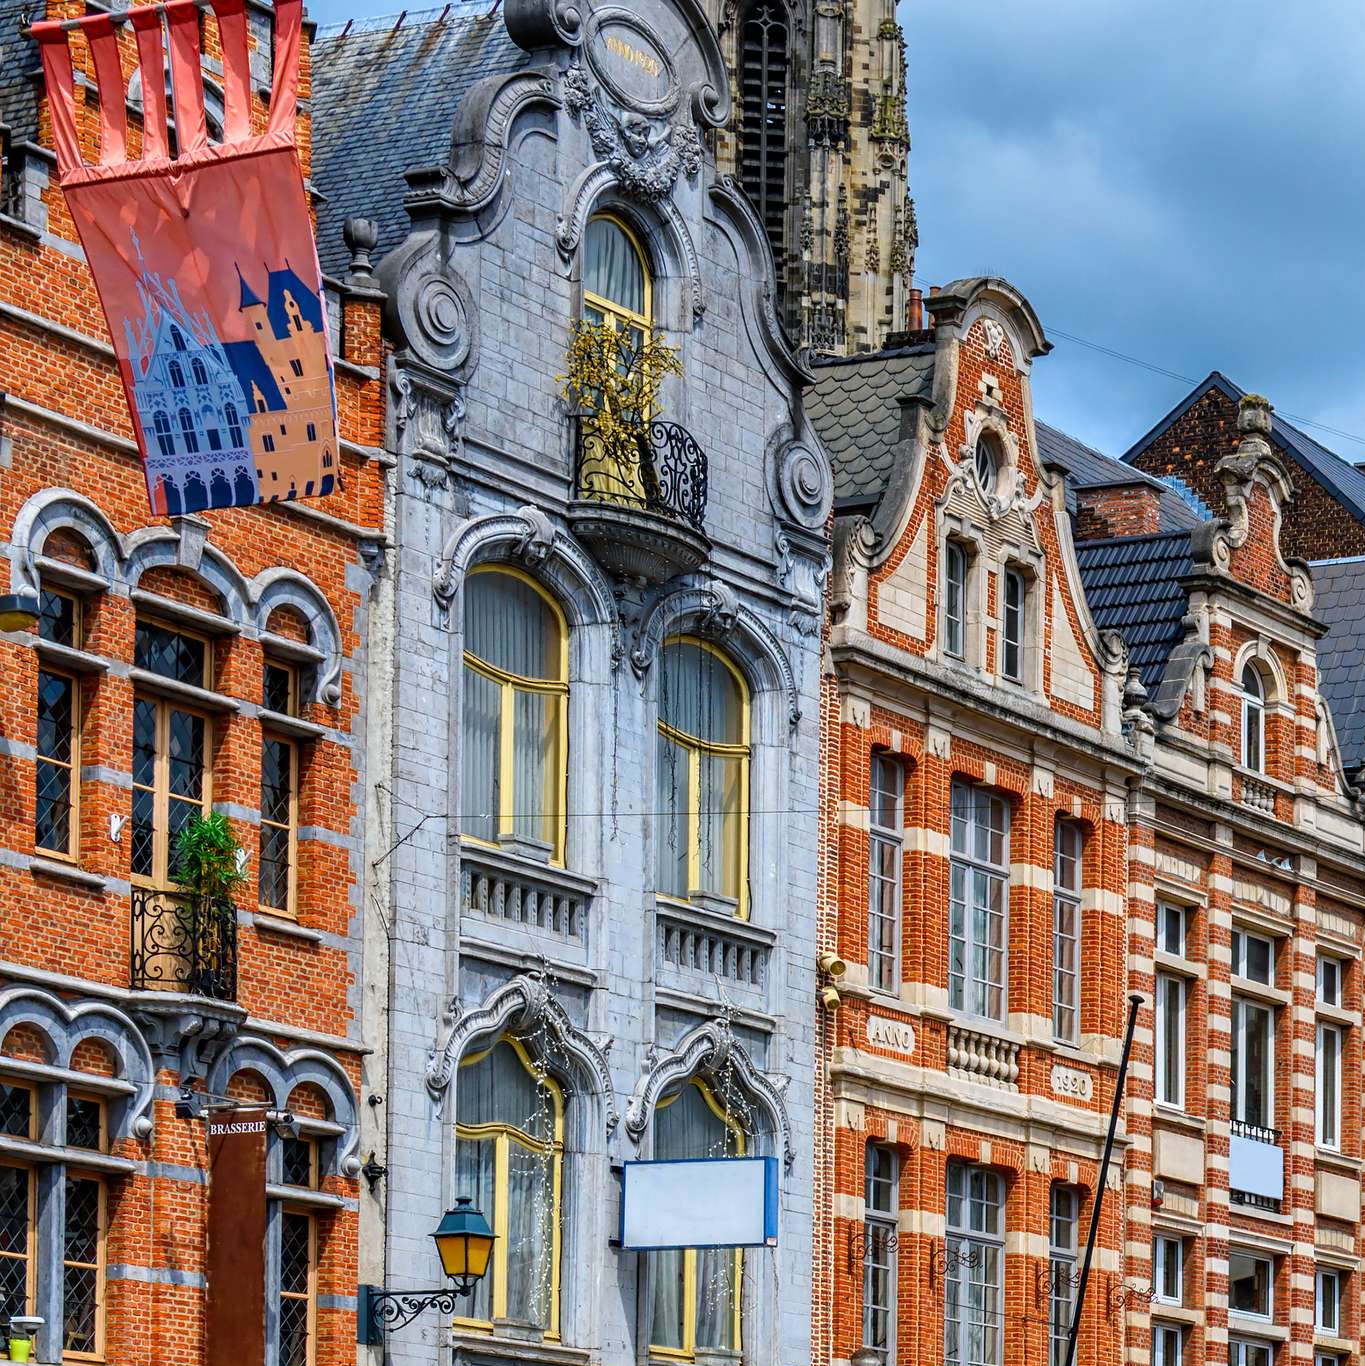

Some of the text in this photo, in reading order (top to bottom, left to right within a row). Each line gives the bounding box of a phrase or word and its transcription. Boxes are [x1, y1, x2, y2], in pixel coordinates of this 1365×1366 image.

[872, 1023, 911, 1050] ANNO
[1056, 1074, 1088, 1096] 1920
[210, 1120, 267, 1136] BRASSERIE
